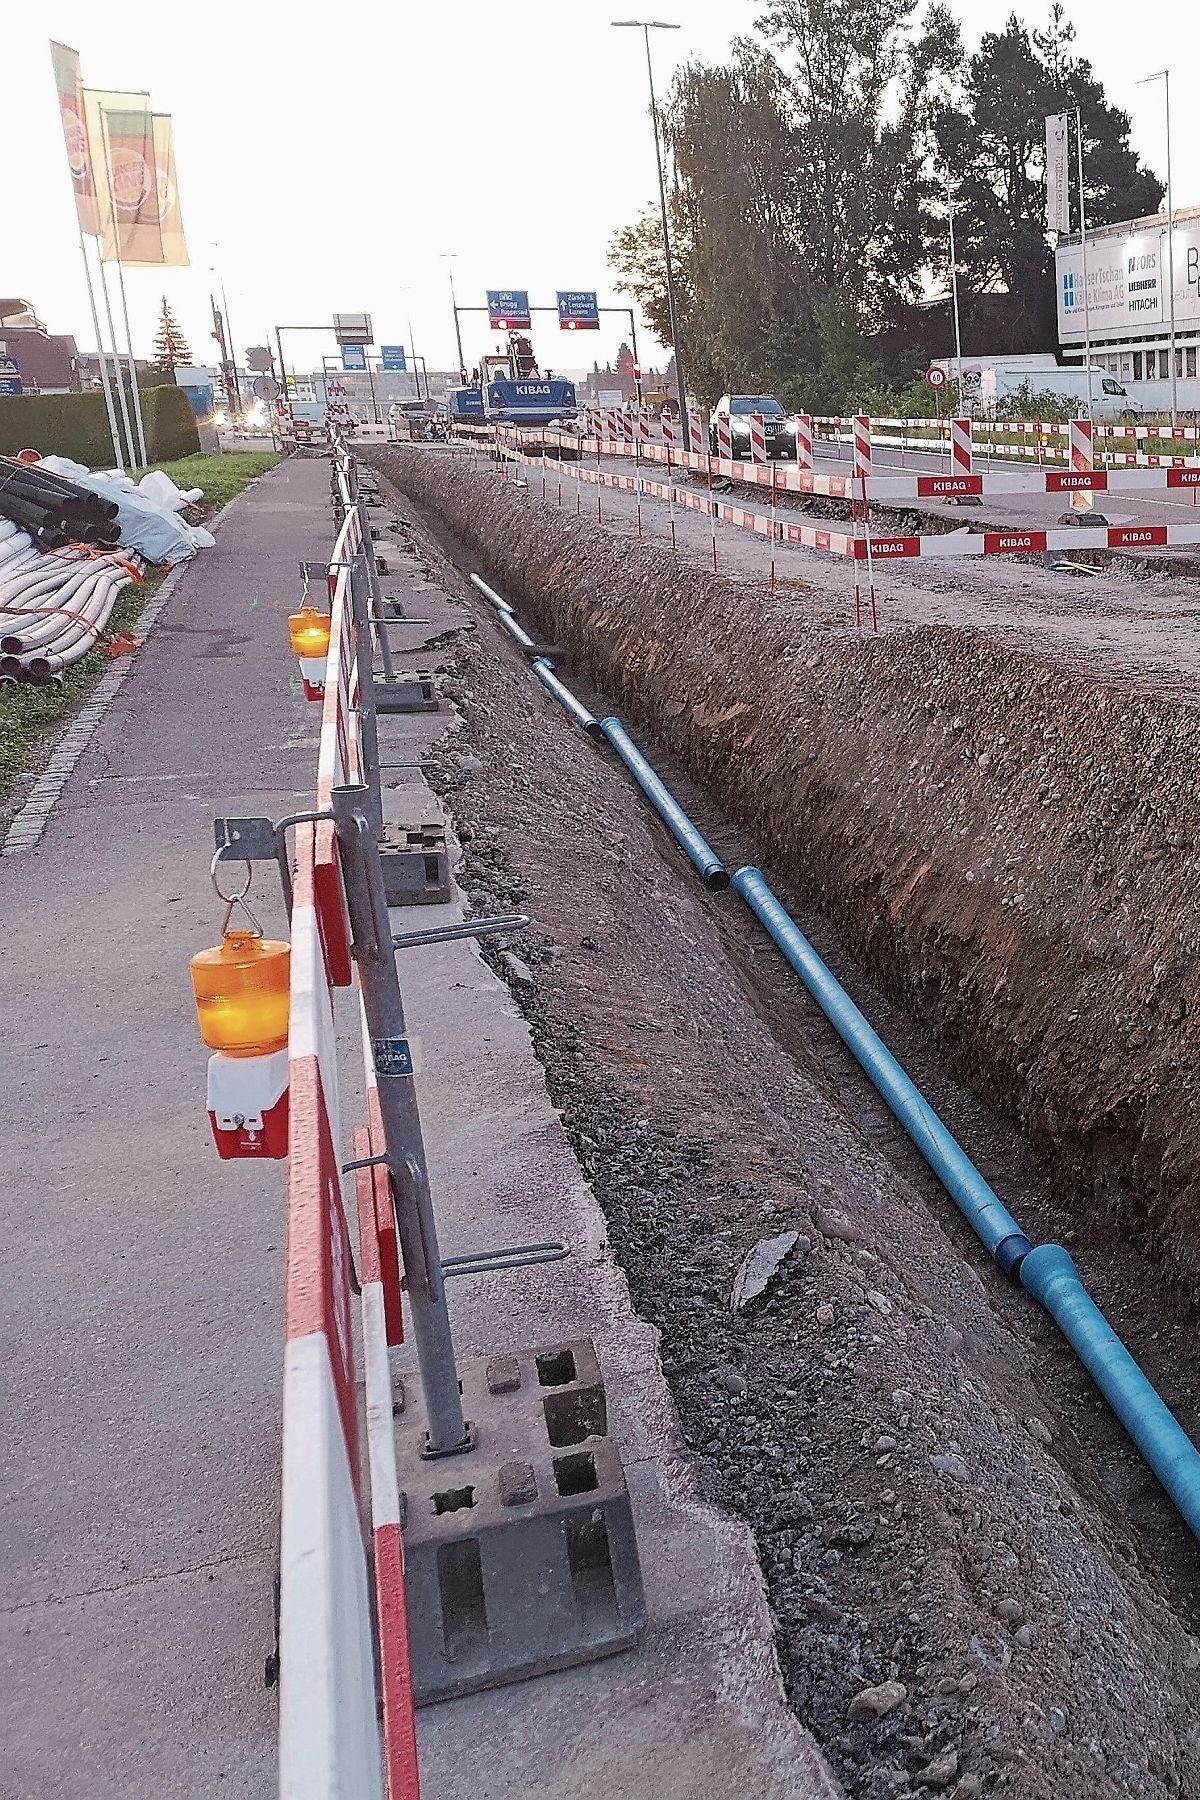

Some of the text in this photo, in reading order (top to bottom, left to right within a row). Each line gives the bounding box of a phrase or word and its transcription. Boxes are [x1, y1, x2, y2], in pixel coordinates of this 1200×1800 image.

[1128, 296, 1158, 312] HITACHI
[932, 374, 941, 382] 60
[515, 385, 551, 395] KIBAG
[933, 480, 967, 492] KIBAG
[1059, 477, 1092, 487] KIBAG
[871, 543, 904, 555] KIBAG
[999, 537, 1032, 549] KIBAG
[1121, 532, 1153, 543] KIBAG
